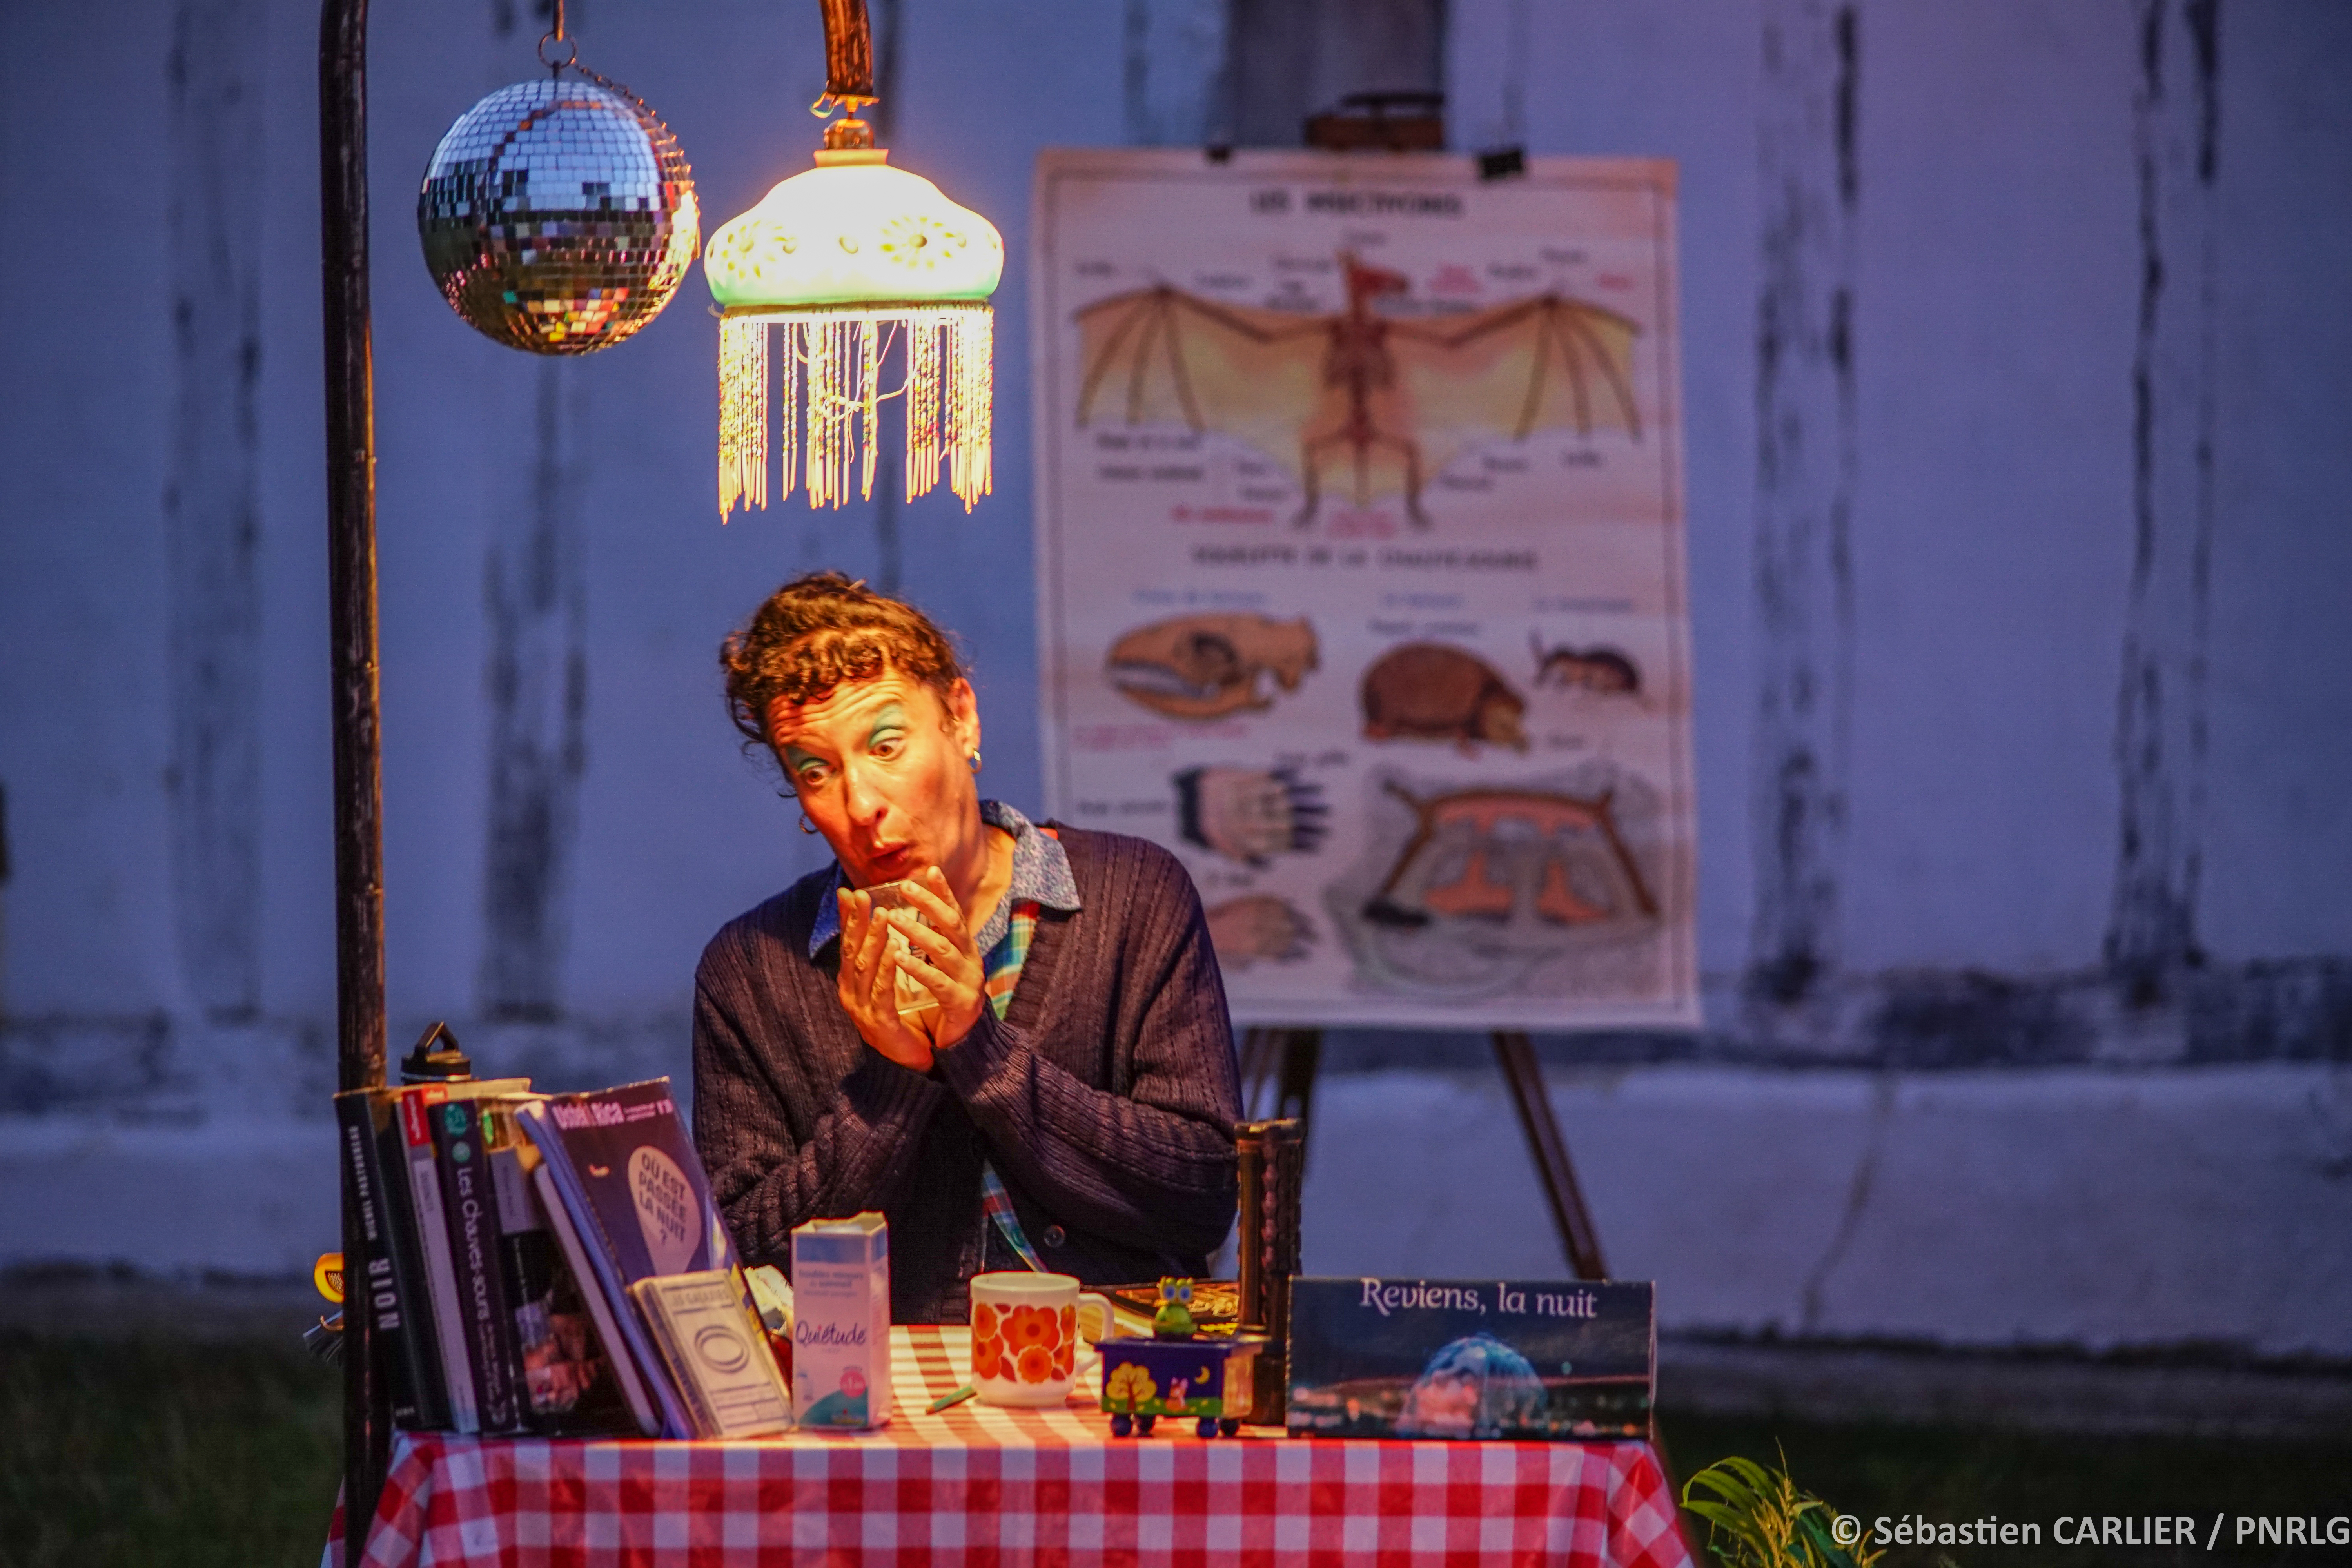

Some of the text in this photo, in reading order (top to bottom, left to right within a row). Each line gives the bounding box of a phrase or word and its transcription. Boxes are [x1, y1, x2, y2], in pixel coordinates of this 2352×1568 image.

[457, 1166, 473, 1197] Les
[662, 1169, 685, 1201] EST
[639, 1190, 685, 1243] LA NUIT
[368, 1258, 400, 1330] NOIR
[1359, 1276, 1598, 1318] Reviens, la nuit
[796, 1319, 867, 1348] Quiétude
